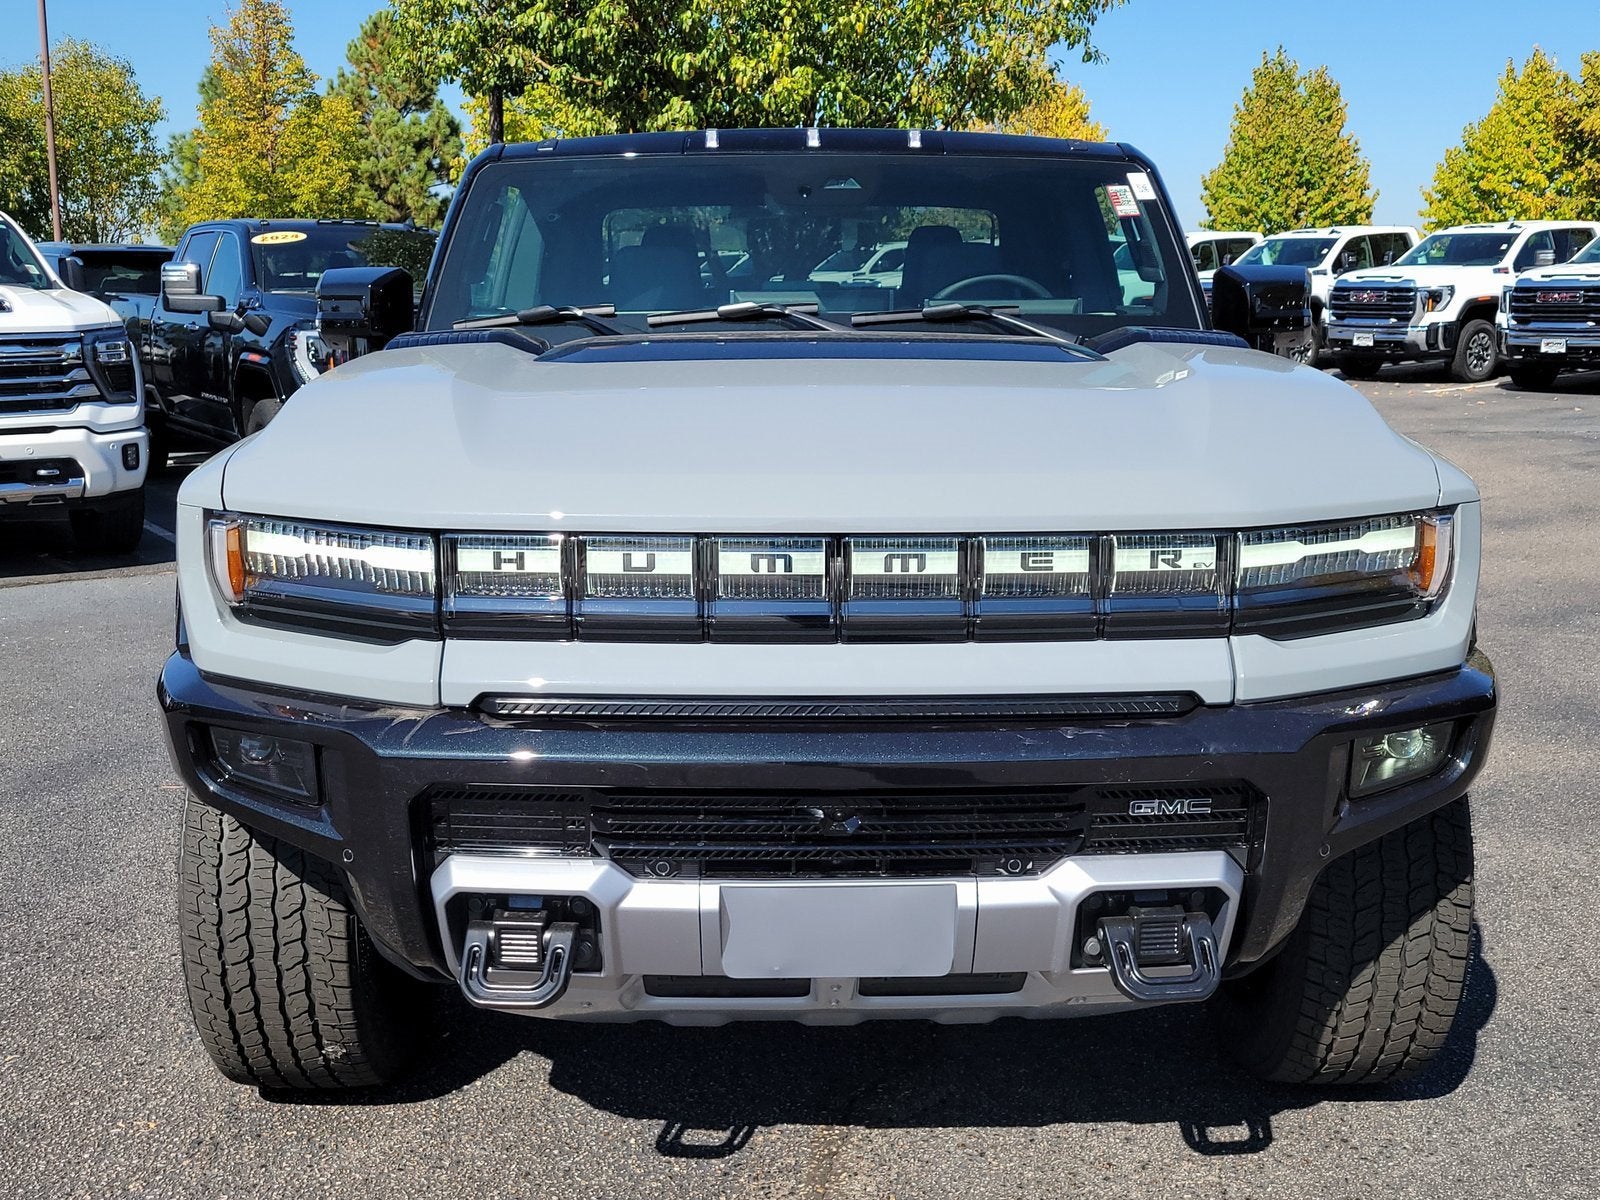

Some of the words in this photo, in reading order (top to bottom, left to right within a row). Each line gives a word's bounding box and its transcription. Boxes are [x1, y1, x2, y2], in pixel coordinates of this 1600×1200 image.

[260, 234, 300, 242] 2024
[492, 550, 1182, 573] HUMMER
[1193, 561, 1214, 569] EV
[1129, 799, 1212, 816] GMC
